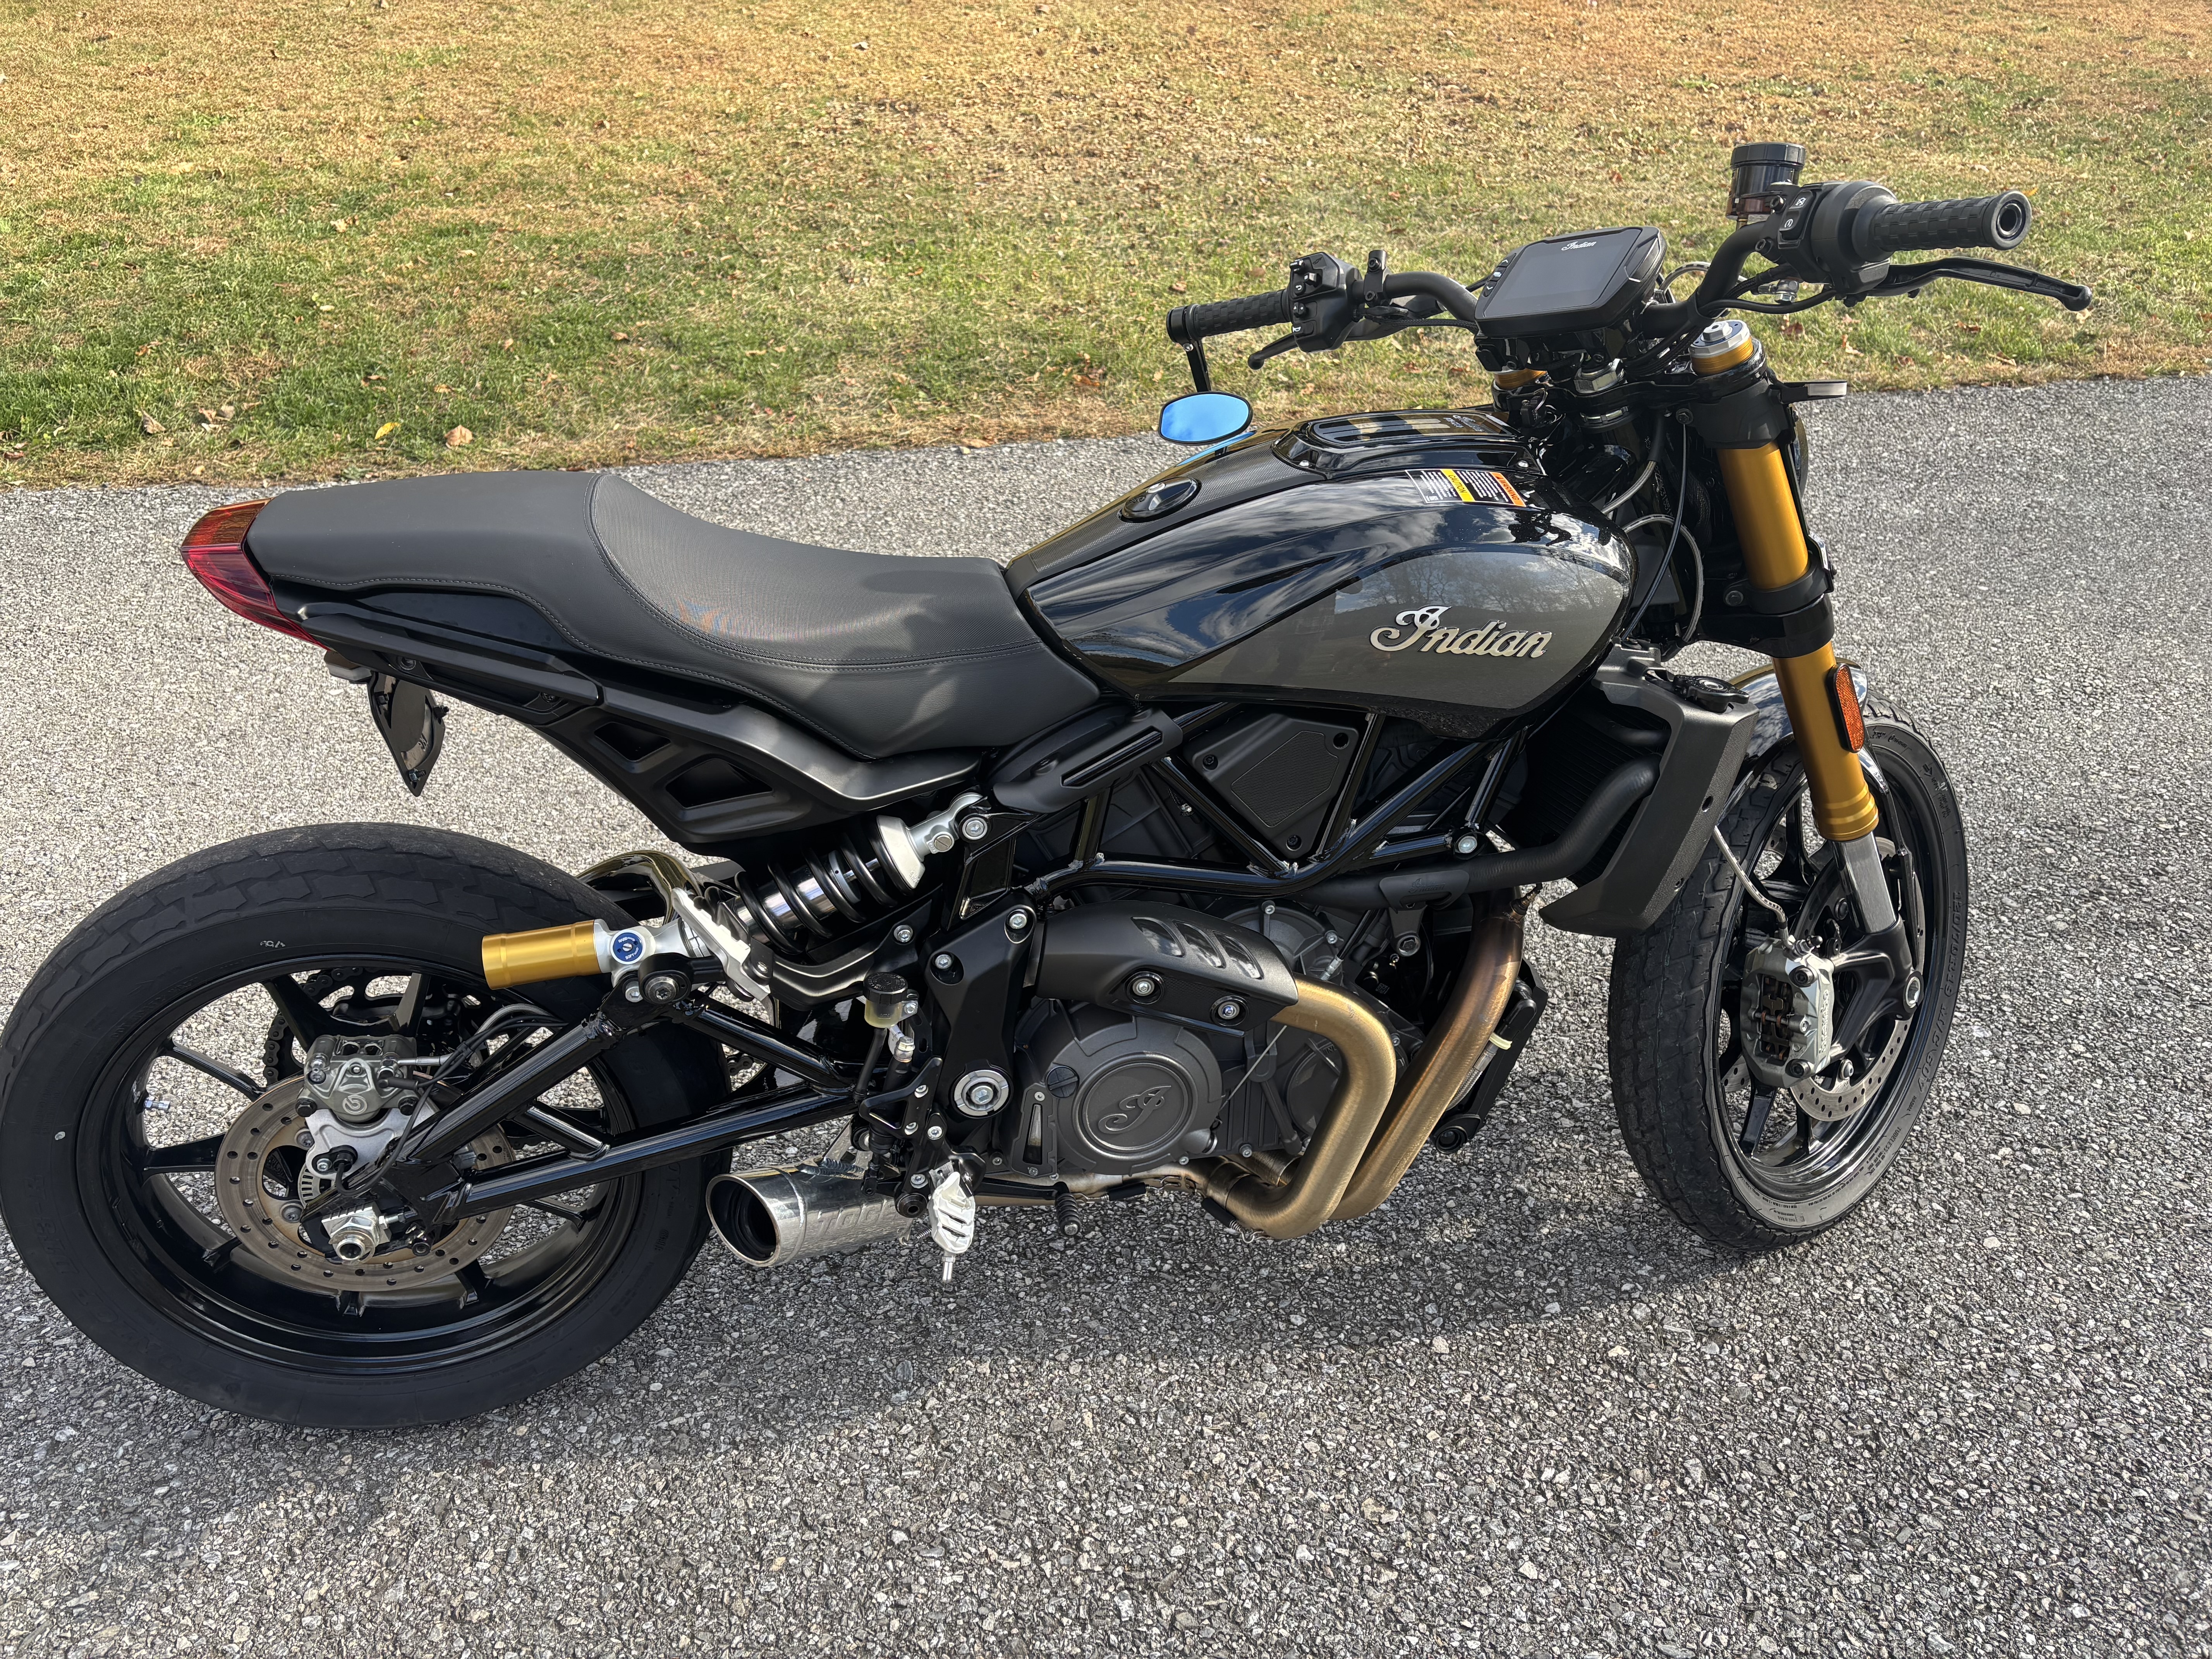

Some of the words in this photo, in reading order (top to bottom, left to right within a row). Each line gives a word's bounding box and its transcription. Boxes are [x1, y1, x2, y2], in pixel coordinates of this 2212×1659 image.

[1561, 240, 1597, 252] Indian
[1448, 475, 1467, 494] CAUTION
[1500, 480, 1519, 501] WARNING
[1369, 605, 1553, 658] Indian
[1945, 891, 1961, 997] 120/70R19
[1819, 989, 1829, 1054] brembo
[1932, 1004, 1948, 1047] M/C
